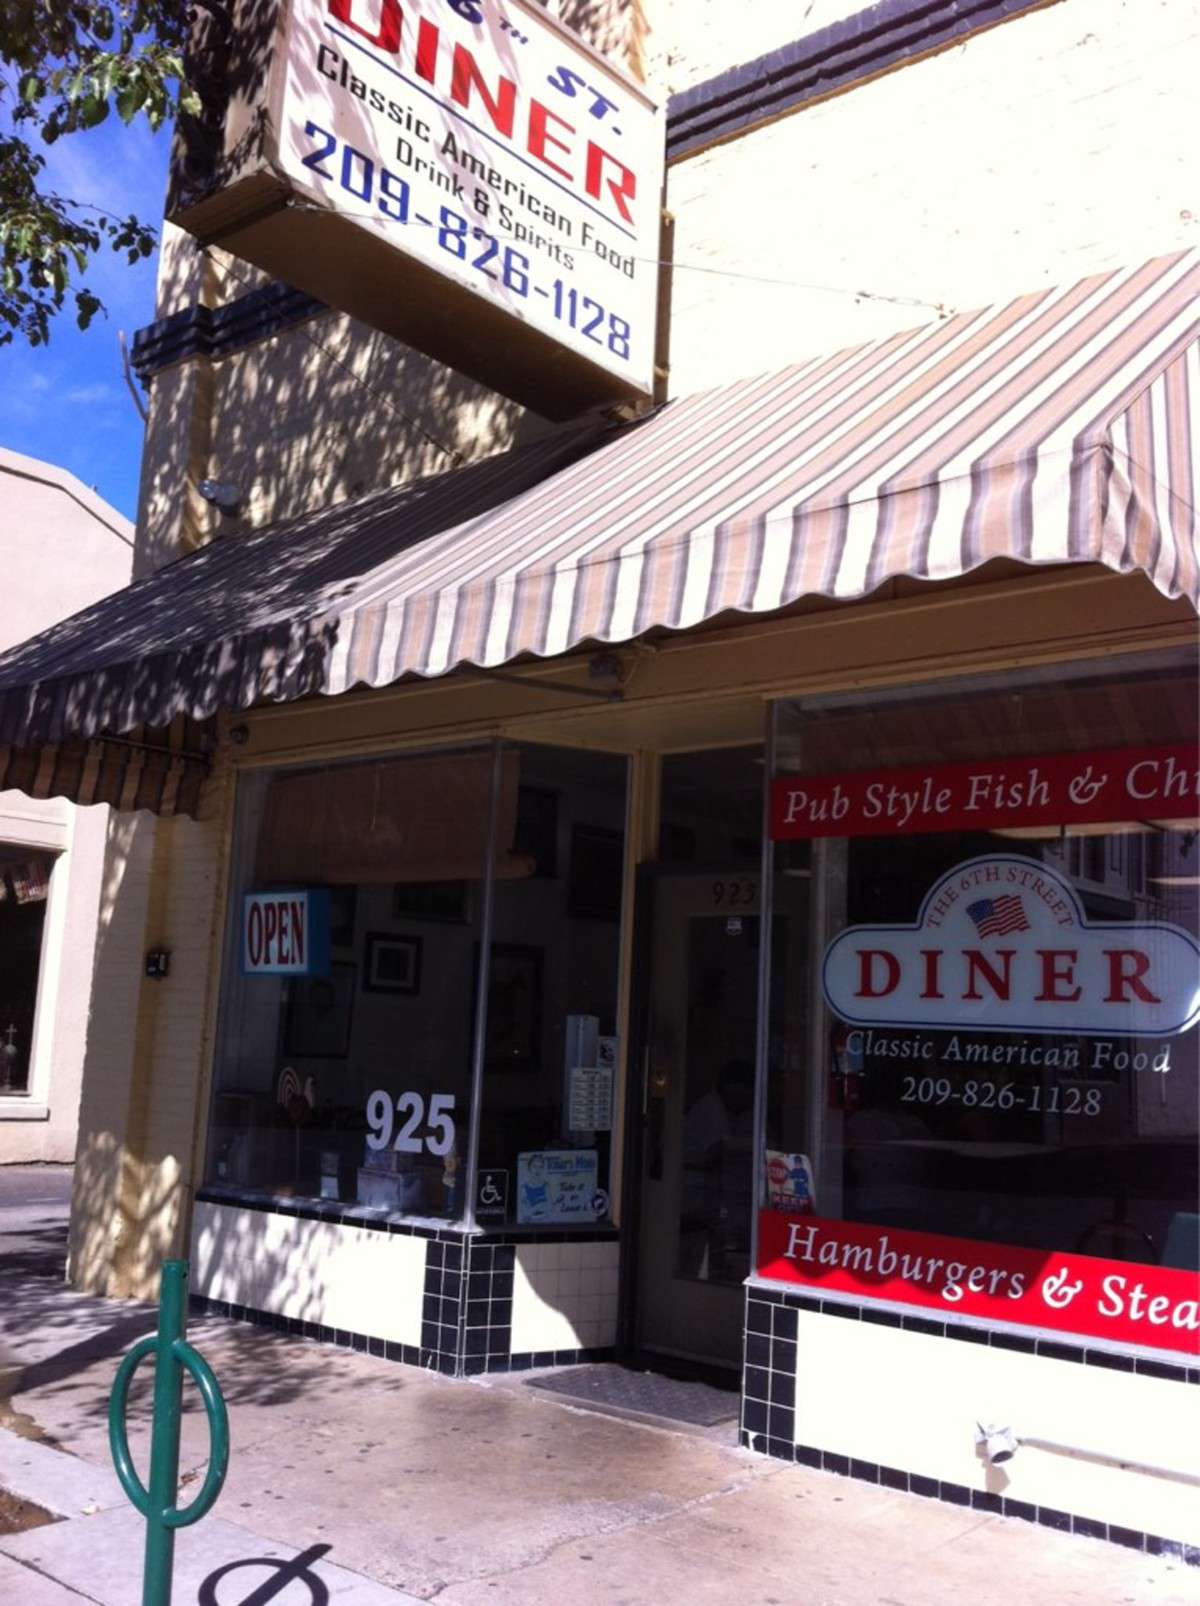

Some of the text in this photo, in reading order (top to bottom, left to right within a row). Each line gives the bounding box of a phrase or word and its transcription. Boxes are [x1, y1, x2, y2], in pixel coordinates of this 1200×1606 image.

[327, 0, 637, 226] DINER
[547, 65, 622, 137] ST.
[316, 43, 635, 279] Classic American Food
[396, 136, 574, 270] Drink & Spirits
[301, 120, 631, 361] 209-826-1128
[784, 786, 849, 823] Pub
[862, 777, 951, 827] Style
[963, 768, 1050, 811] Fish
[1069, 765, 1108, 804] &
[927, 866, 1075, 930] THE 6TH STREET
[247, 901, 304, 966] OPEN
[853, 949, 1161, 1004] DINER
[845, 1031, 1171, 1073] Classic American Food
[366, 1090, 455, 1156] 925
[900, 1076, 1101, 1116] 209-826-1128
[784, 1223, 1200, 1330] Hamburgers & Stea
